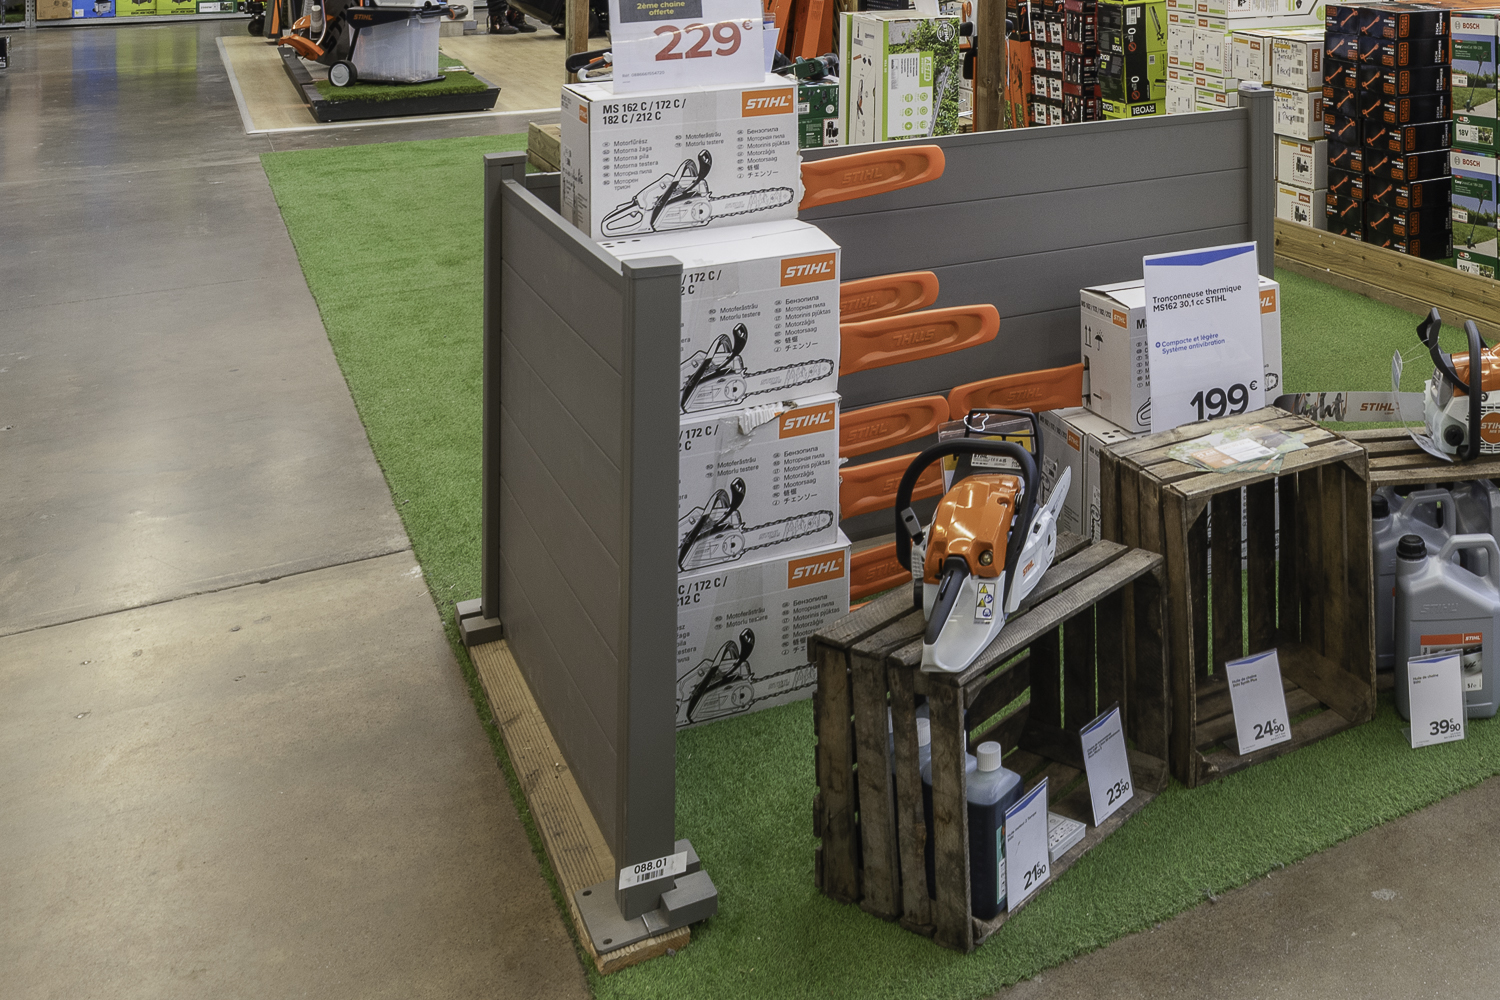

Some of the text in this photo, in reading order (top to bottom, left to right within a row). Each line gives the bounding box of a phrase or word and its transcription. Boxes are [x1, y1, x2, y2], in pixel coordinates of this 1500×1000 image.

[603, 99, 680, 114] MS 162 C 172 C
[746, 96, 790, 109] STIHL
[603, 111, 661, 125] 182 C 212 C
[1458, 129, 1468, 137] 18V
[842, 167, 882, 184] STIHL
[784, 262, 832, 278] STIHL
[1153, 284, 1242, 304] Tronçonneuse thermique
[1153, 303, 1177, 312] MS162
[1180, 301, 1195, 309] 30,1
[1206, 296, 1226, 304] STIHL
[1162, 337, 1192, 348] Compacte
[1201, 333, 1218, 341] légère
[1162, 338, 1225, 355] Système antivibration
[1360, 403, 1395, 412] STIHL
[634, 858, 667, 874] 088.01
